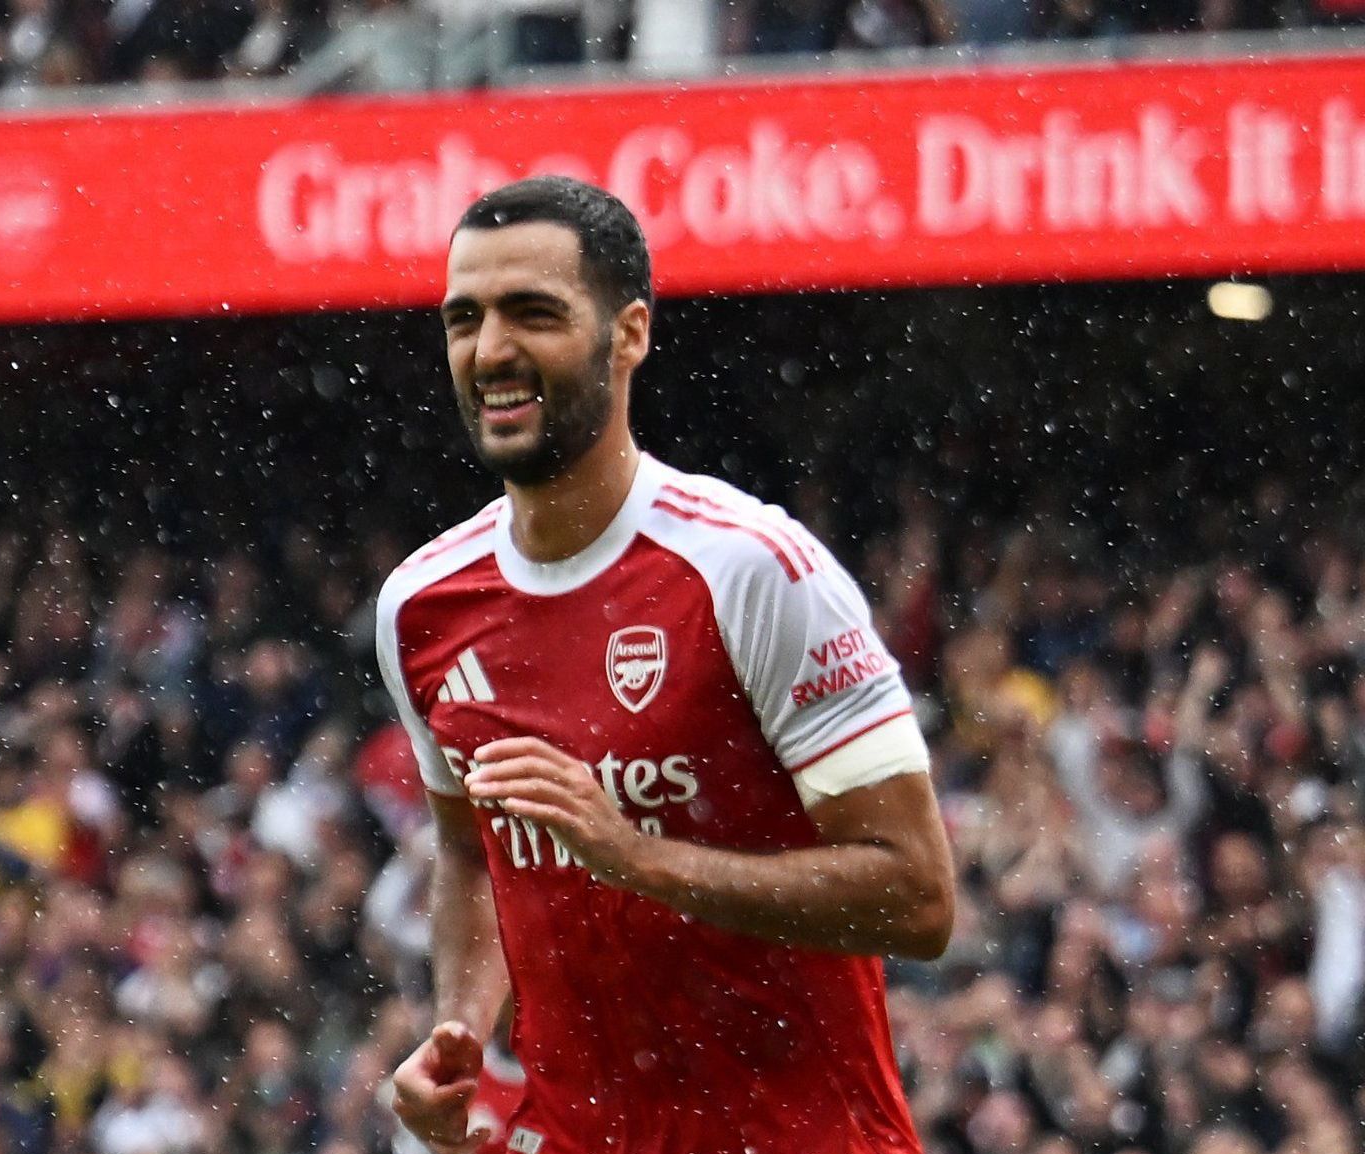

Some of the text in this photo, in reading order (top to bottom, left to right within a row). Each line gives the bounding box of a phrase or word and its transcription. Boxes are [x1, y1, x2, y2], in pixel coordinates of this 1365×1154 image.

[607, 122, 907, 248] Coke.
[915, 106, 1207, 236] Drink
[1227, 100, 1297, 224] it
[808, 626, 867, 667] VISIT
